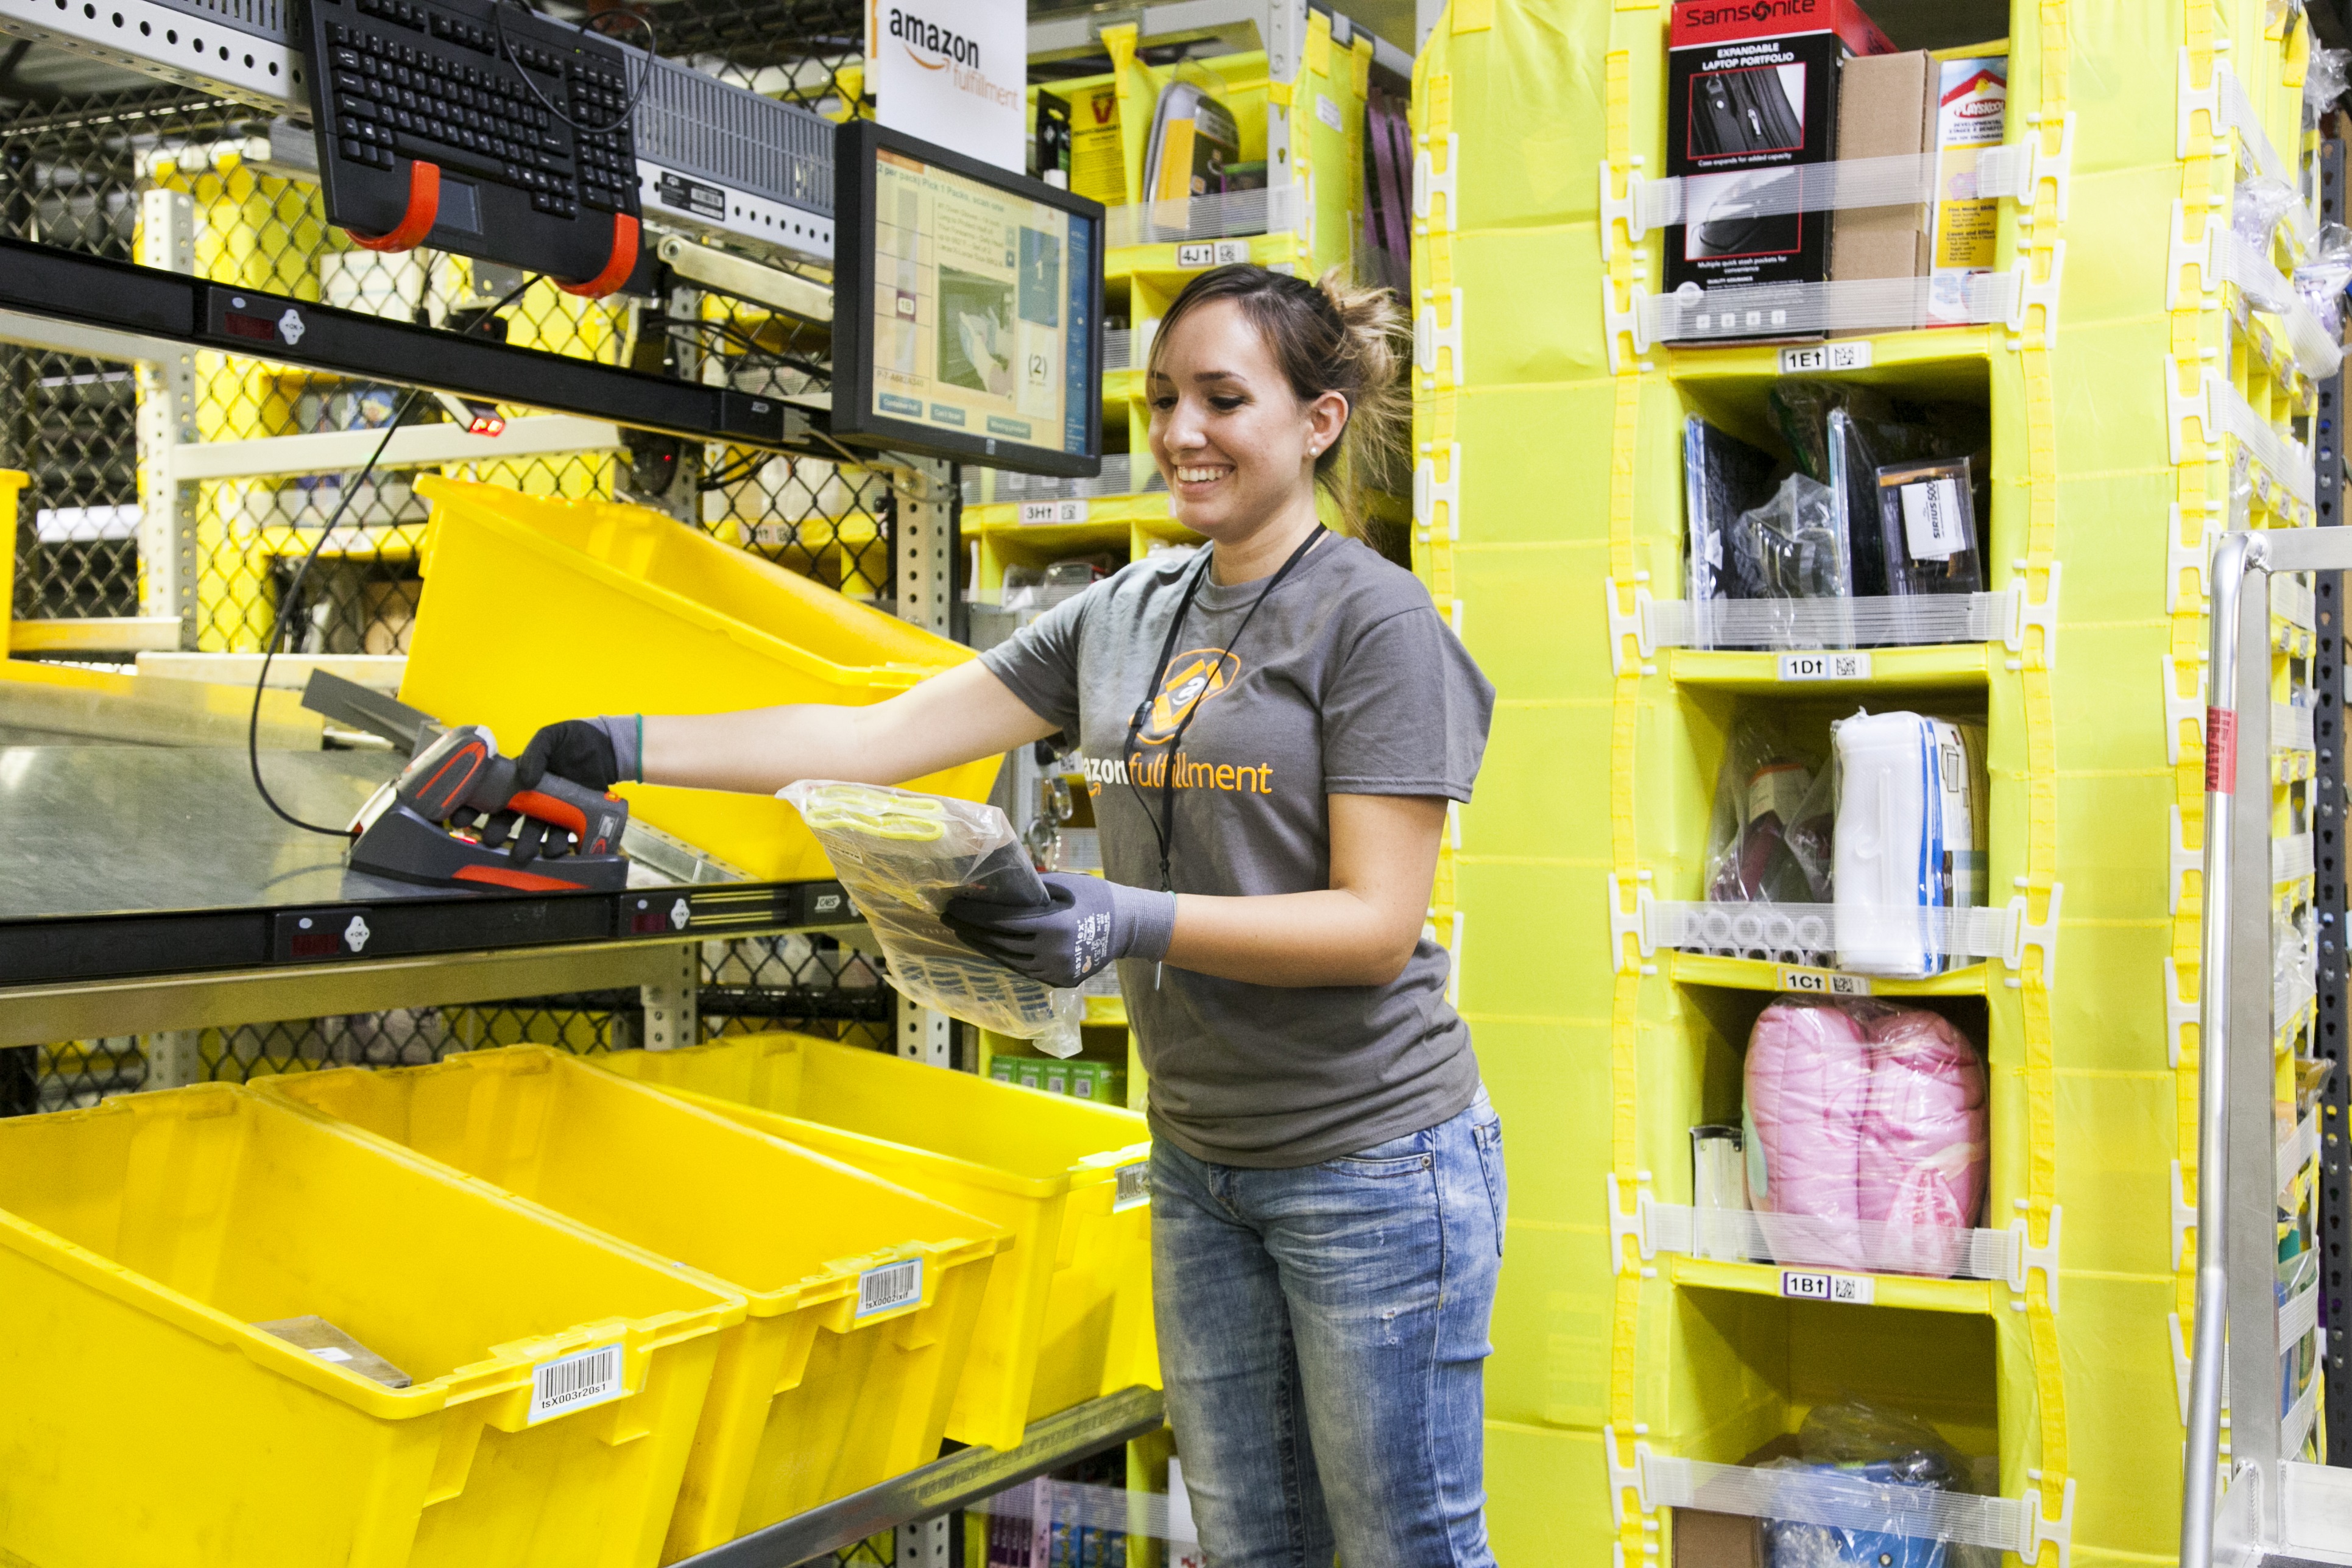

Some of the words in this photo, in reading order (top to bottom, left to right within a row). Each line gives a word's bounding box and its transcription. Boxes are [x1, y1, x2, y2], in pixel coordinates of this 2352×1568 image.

[890, 8, 979, 69] amazon
[1717, 43, 1779, 58] EXPANDABLE
[1703, 56, 1739, 71] LAPTOP
[1740, 52, 1794, 66] PORTFOLIO
[953, 63, 1019, 110] fulfillment
[1182, 248, 1200, 262] 4J
[1028, 353, 1048, 381] (2)
[1789, 352, 1814, 368] 1E
[1026, 506, 1047, 519] 3H
[1790, 661, 1813, 674] 1D
[1789, 975, 1813, 989] 1C
[1790, 1278, 1813, 1293] 1B
